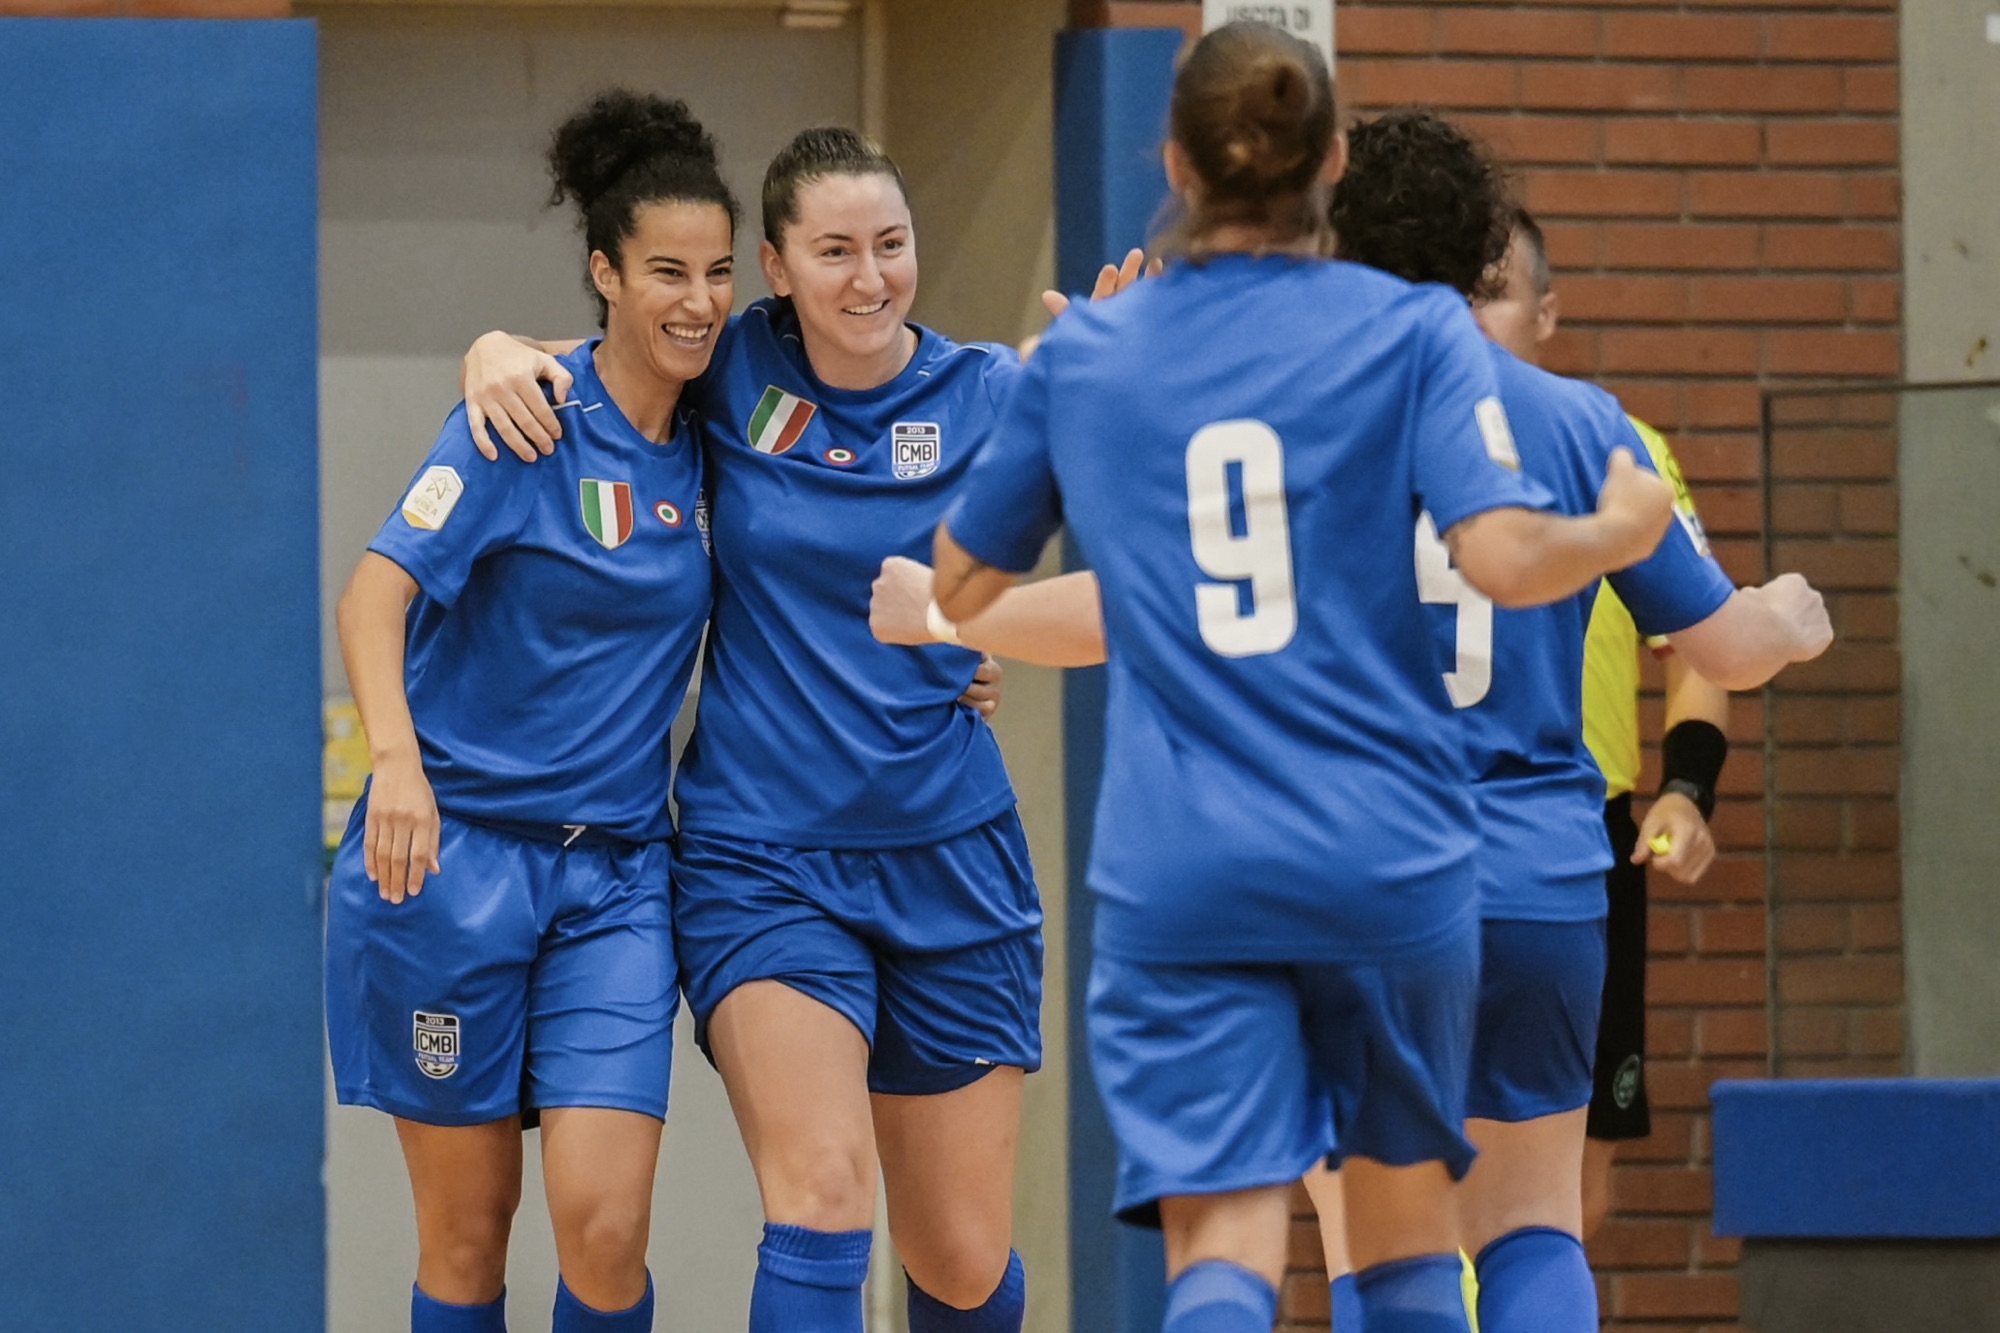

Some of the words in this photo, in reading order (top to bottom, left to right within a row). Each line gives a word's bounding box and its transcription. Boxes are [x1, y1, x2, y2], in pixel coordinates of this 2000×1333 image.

[900, 444, 932, 463] CMB
[1185, 418, 1298, 658] 9
[425, 1016, 445, 1026] 2013
[420, 1032, 452, 1054] CMB
